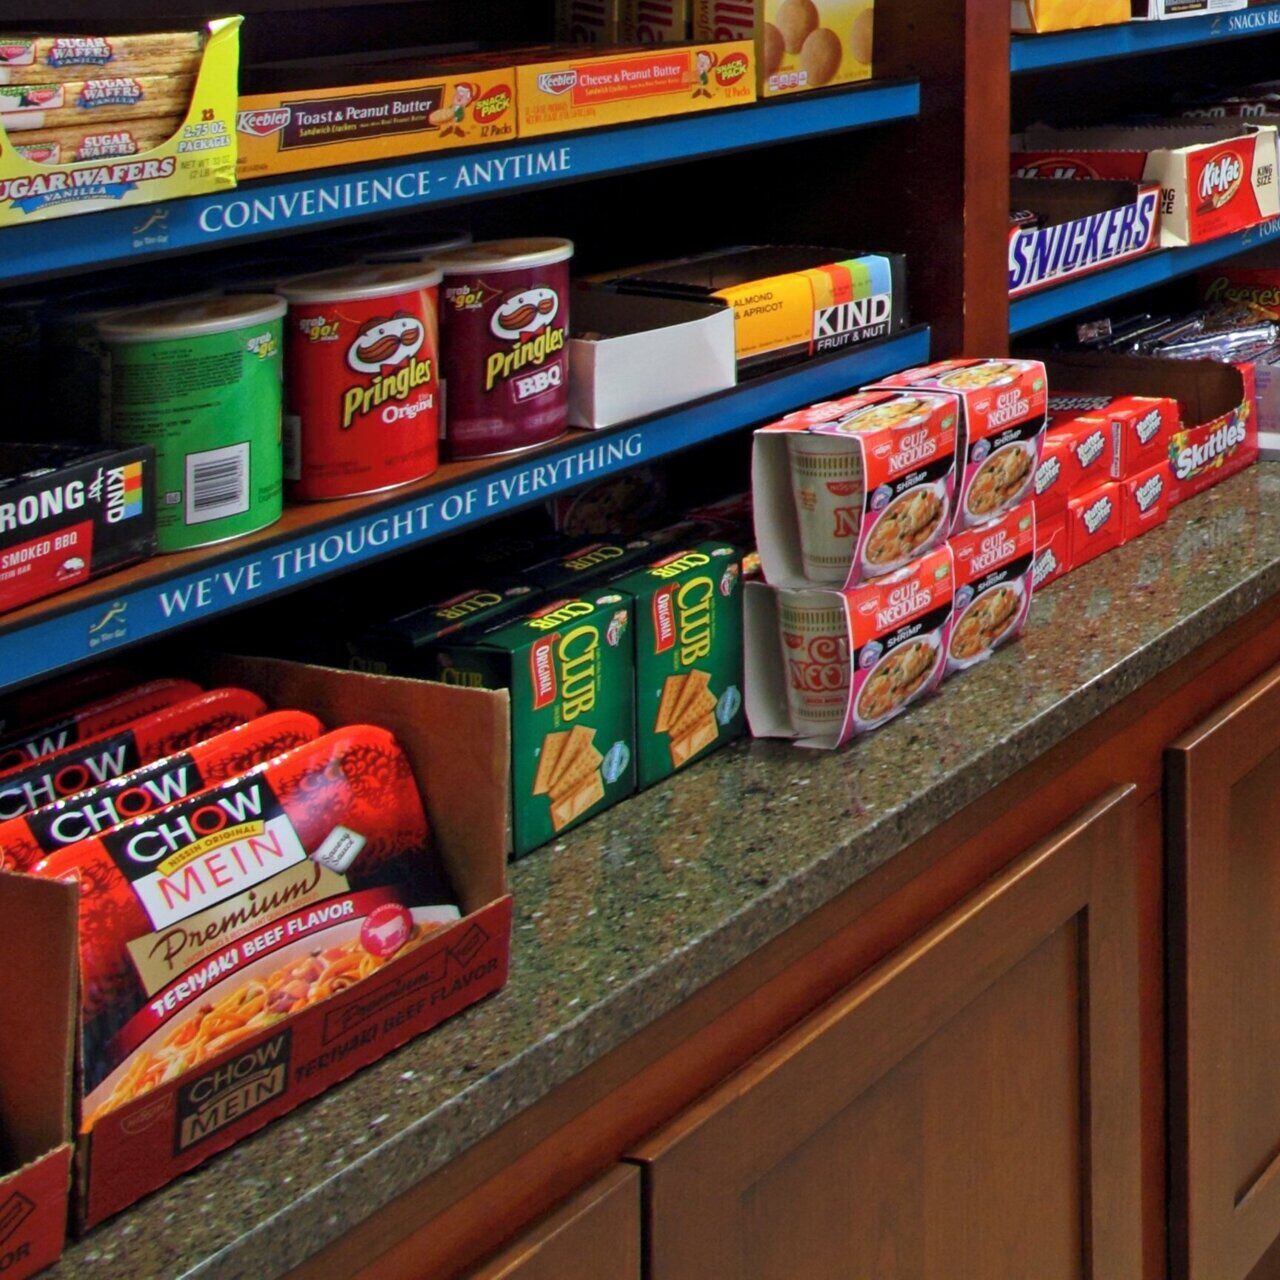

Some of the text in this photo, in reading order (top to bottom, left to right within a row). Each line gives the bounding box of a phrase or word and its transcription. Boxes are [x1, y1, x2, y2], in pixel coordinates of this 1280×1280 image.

[1227, 9, 1266, 32] SNACKS
[52, 47, 112, 59] WAFERS
[56, 37, 106, 49] SUGAR
[540, 72, 577, 90] Keebler
[580, 64, 681, 87] Cheese Peanut Butter
[716, 60, 743, 74] SNACK
[721, 66, 748, 80] PACK
[83, 86, 141, 100] WAFERS
[476, 92, 508, 110] SNACK
[480, 98, 511, 116] PACK
[238, 109, 290, 132] Keebler
[296, 111, 334, 126] Toast
[335, 109, 344, 122] &
[346, 104, 389, 121] Peanut
[392, 99, 433, 116] Butter
[84, 132, 131, 147] SUGAR
[183, 121, 226, 138] 2.75 OZ
[299, 126, 331, 138] Sandwich
[178, 135, 231, 154] PACKAGES
[71, 156, 177, 186] WAFERS
[1200, 157, 1240, 198] KitKat
[1256, 163, 1273, 177] KING
[1256, 174, 1273, 188] SIZE
[44, 185, 108, 202] VANILLA
[198, 146, 572, 234] CONVENIENCE ANYTIME
[1009, 191, 1157, 291] SNICKERS
[452, 291, 484, 311] go!
[733, 292, 774, 308] ALMOND
[744, 301, 784, 318] APRICOT
[812, 293, 892, 338] KIND
[310, 322, 340, 339] go!
[817, 335, 849, 352] FRUIT
[861, 324, 886, 341] NUT
[485, 325, 565, 393] Pringles
[342, 356, 432, 429] Pringles
[514, 365, 561, 400] BBQ
[381, 394, 433, 424] Original
[988, 398, 1031, 429] NOODLES
[996, 389, 1022, 410] CUP
[899, 429, 930, 450] CUP
[993, 429, 1022, 448] SHRIMP
[1176, 421, 1246, 480] Skittles
[887, 438, 938, 473] NOODLES
[87, 466, 125, 524] & KIND
[895, 471, 928, 494] SHRIMP
[159, 432, 644, 619] WE'VE THOUGHT OF EVERYTHING
[2, 530, 78, 570] SMOKED BBQ
[979, 529, 1007, 555] CUP
[651, 553, 711, 578] CLUB
[970, 539, 1016, 577] NOODLES
[887, 579, 920, 607] CUP
[977, 570, 1008, 593] SHRIMP
[523, 601, 595, 630] CLUB
[657, 593, 673, 641] ORIGINAL
[677, 575, 715, 667] CLUB
[875, 589, 932, 631] NOODLES
[886, 623, 923, 649] SHRIMP
[536, 644, 553, 697] ORIGINAL
[557, 624, 600, 723] CLUB
[0, 744, 127, 821] CHOW
[51, 767, 188, 844] CHOW
[126, 783, 263, 864] CHOW
[167, 825, 257, 869] NISSIN ORIGINAL
[322, 832, 352, 865] Savory
[156, 828, 285, 911] MEIN
[148, 854, 323, 971] Premium
[150, 947, 241, 1019] TERIYAKI
[242, 929, 286, 960] BEEF
[286, 899, 356, 937] FLAVOR
[189, 1034, 284, 1104] CHOW
[188, 1068, 280, 1137] MEIN
